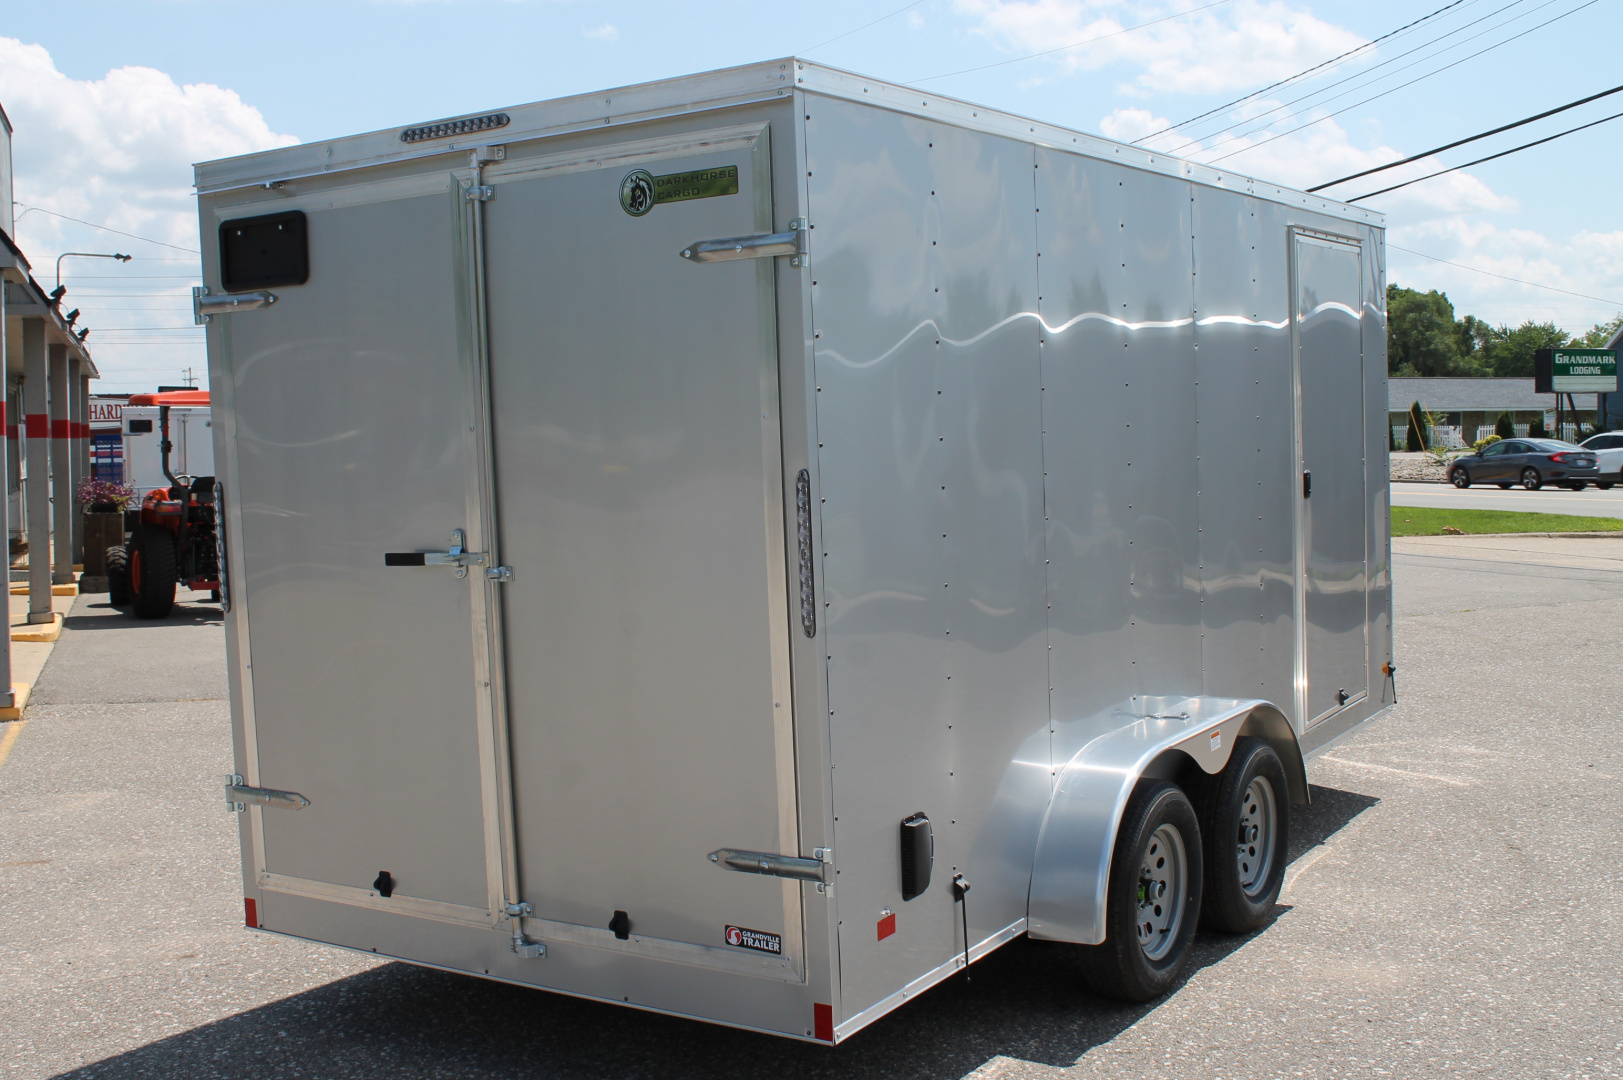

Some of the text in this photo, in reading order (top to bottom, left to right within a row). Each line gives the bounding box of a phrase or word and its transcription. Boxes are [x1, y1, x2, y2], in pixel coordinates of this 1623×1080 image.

[657, 169, 736, 187] DARKHORSE
[657, 187, 700, 200] CARGO
[1570, 366, 1601, 375] LODGING
[742, 930, 780, 943] GRANDVILLE
[742, 937, 780, 952] TRAILER
